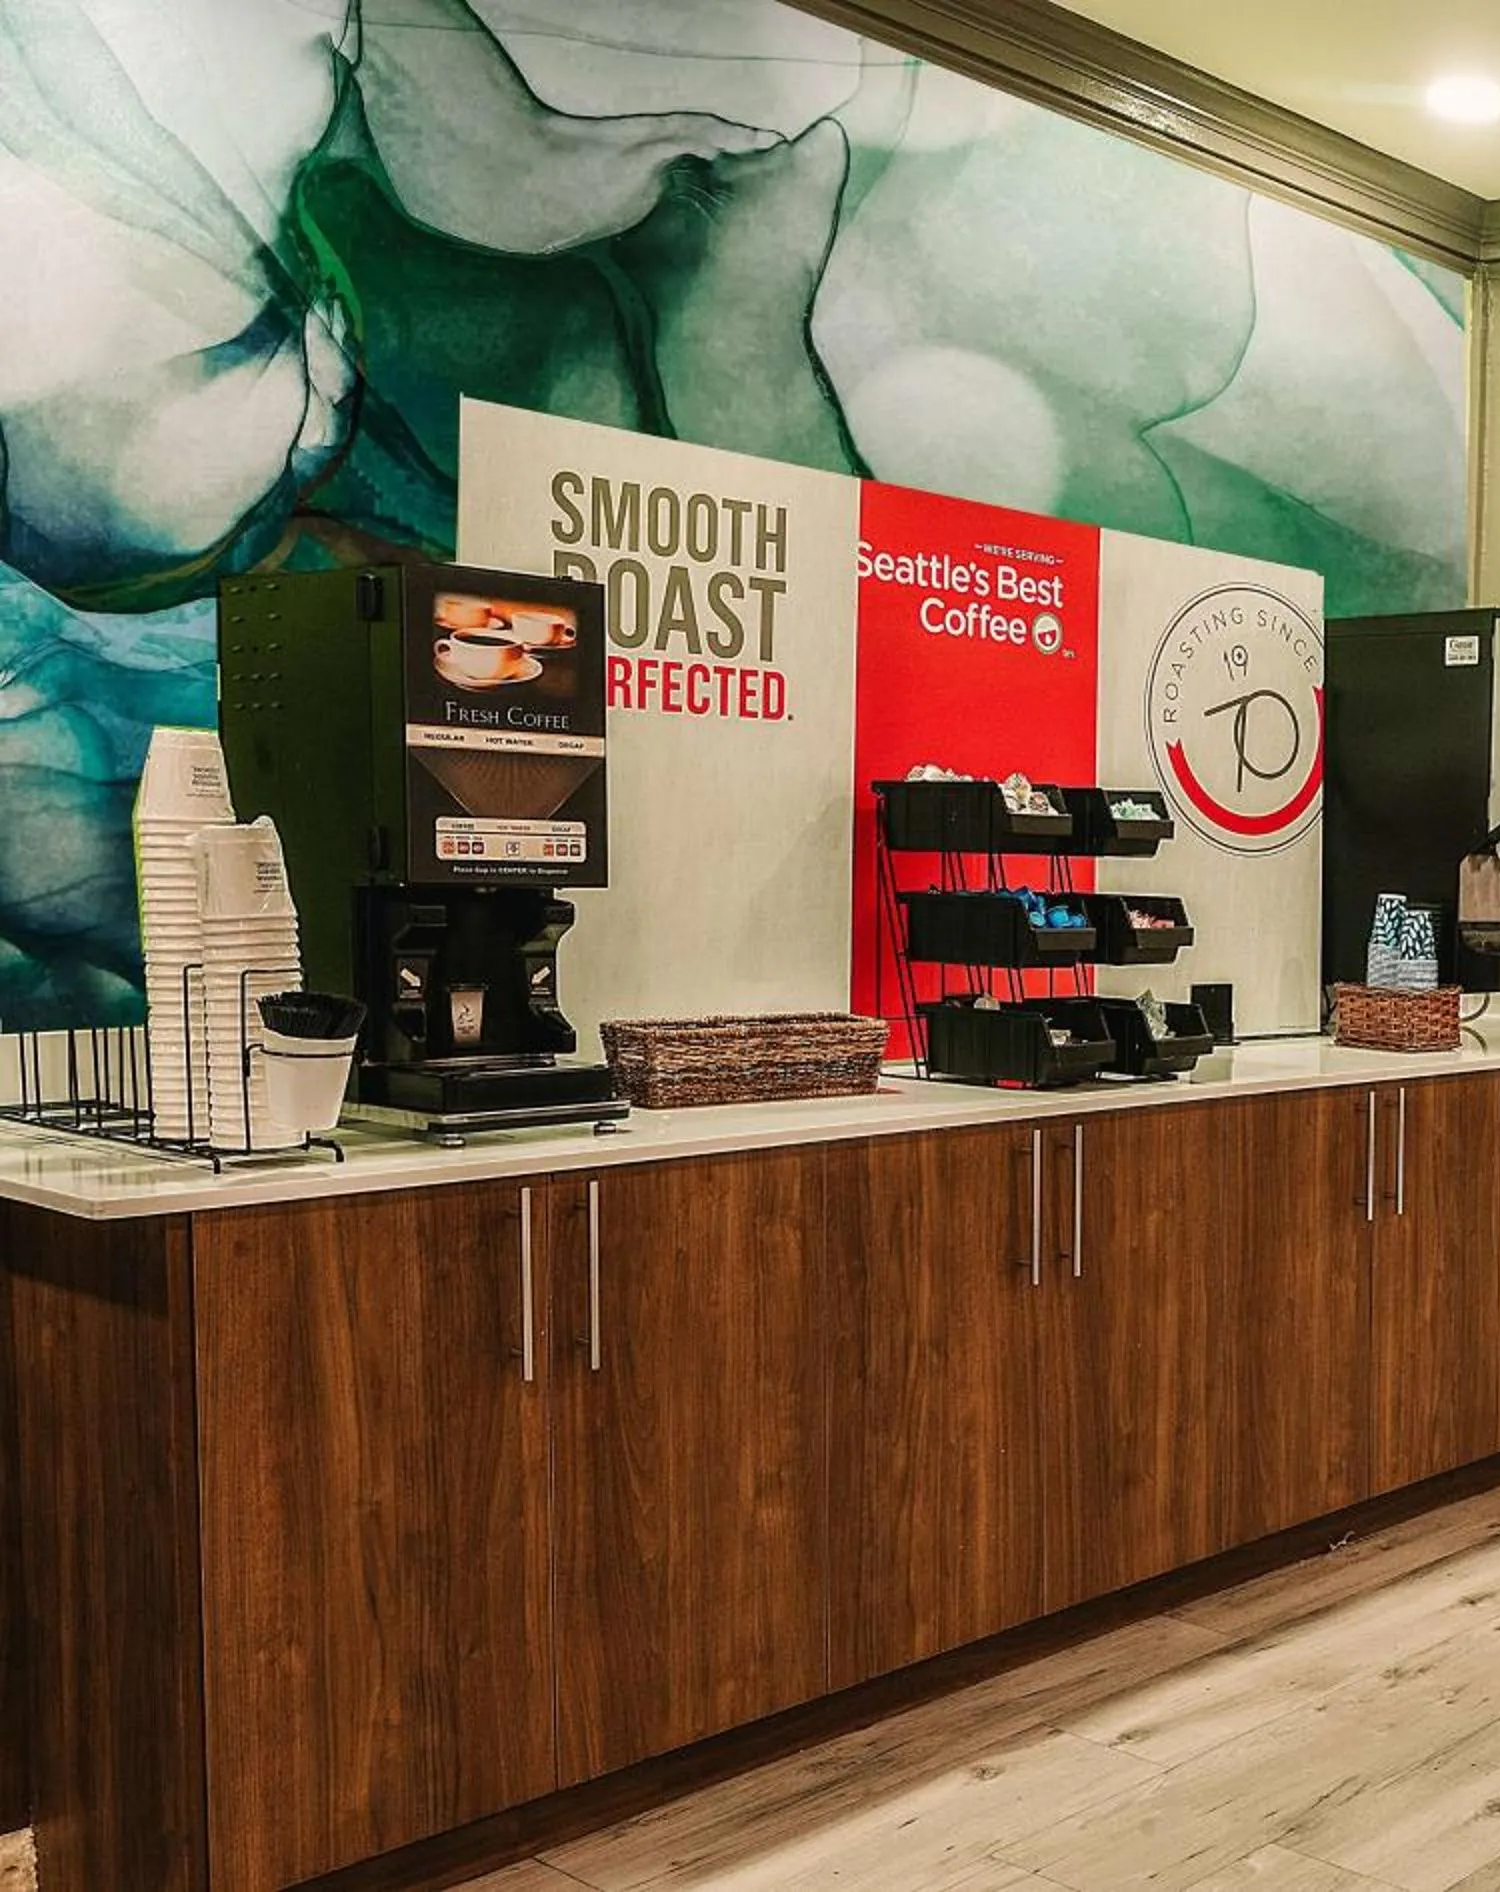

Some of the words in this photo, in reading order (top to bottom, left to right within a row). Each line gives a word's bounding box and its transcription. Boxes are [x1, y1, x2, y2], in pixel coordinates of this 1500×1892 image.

[551, 471, 788, 573] SMOOTH
[856, 541, 990, 597] Seattle's
[997, 565, 1064, 608] Best
[1015, 549, 1055, 565] SERVING
[920, 597, 1027, 645] Coffee
[608, 655, 794, 721] RFECTED.
[1163, 607, 1245, 723] ROASTING
[1257, 608, 1319, 673] SINCE
[1223, 644, 1249, 681] 19
[445, 700, 499, 724] FRESH
[507, 706, 569, 729] COFFEE
